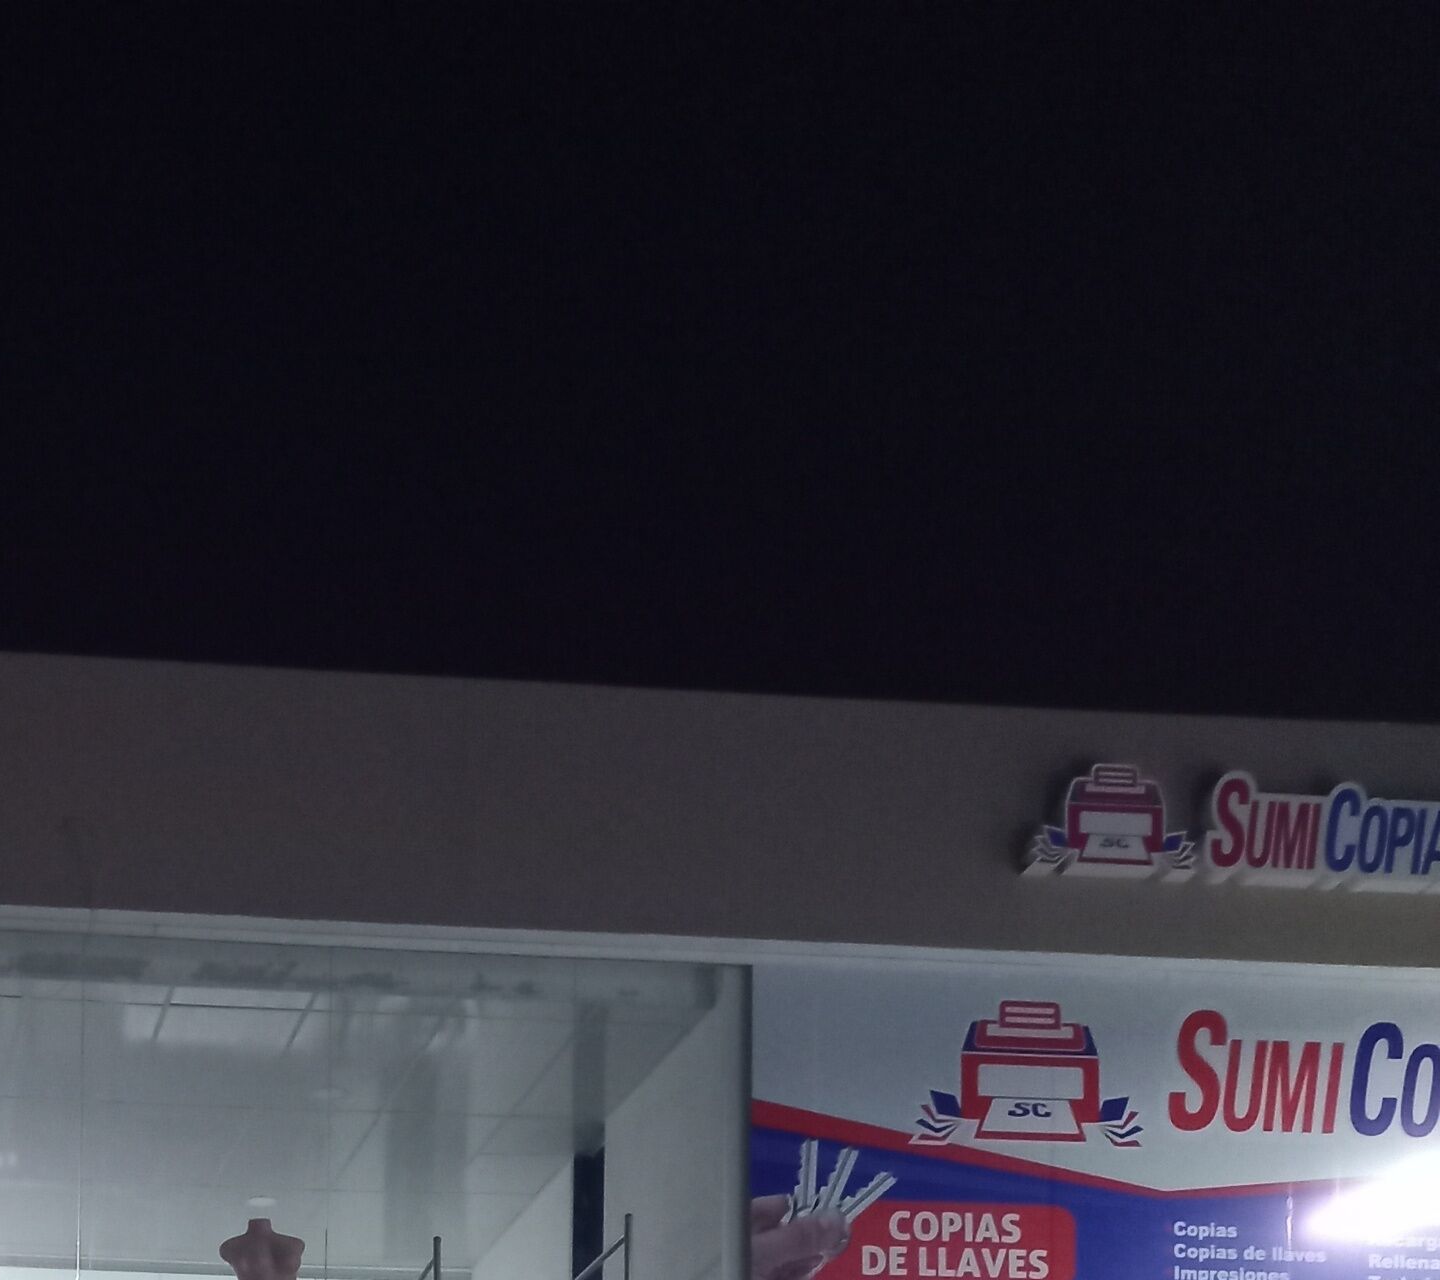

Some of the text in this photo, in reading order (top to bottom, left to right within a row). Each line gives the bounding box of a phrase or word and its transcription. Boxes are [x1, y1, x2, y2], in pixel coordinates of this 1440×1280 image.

[1007, 1101, 1052, 1119] SC
[888, 1211, 1022, 1244] COPIAS
[1173, 1221, 1238, 1240] Copias
[861, 1245, 1049, 1280] DE LLAVES
[1173, 1243, 1327, 1263] Copias de llaves
